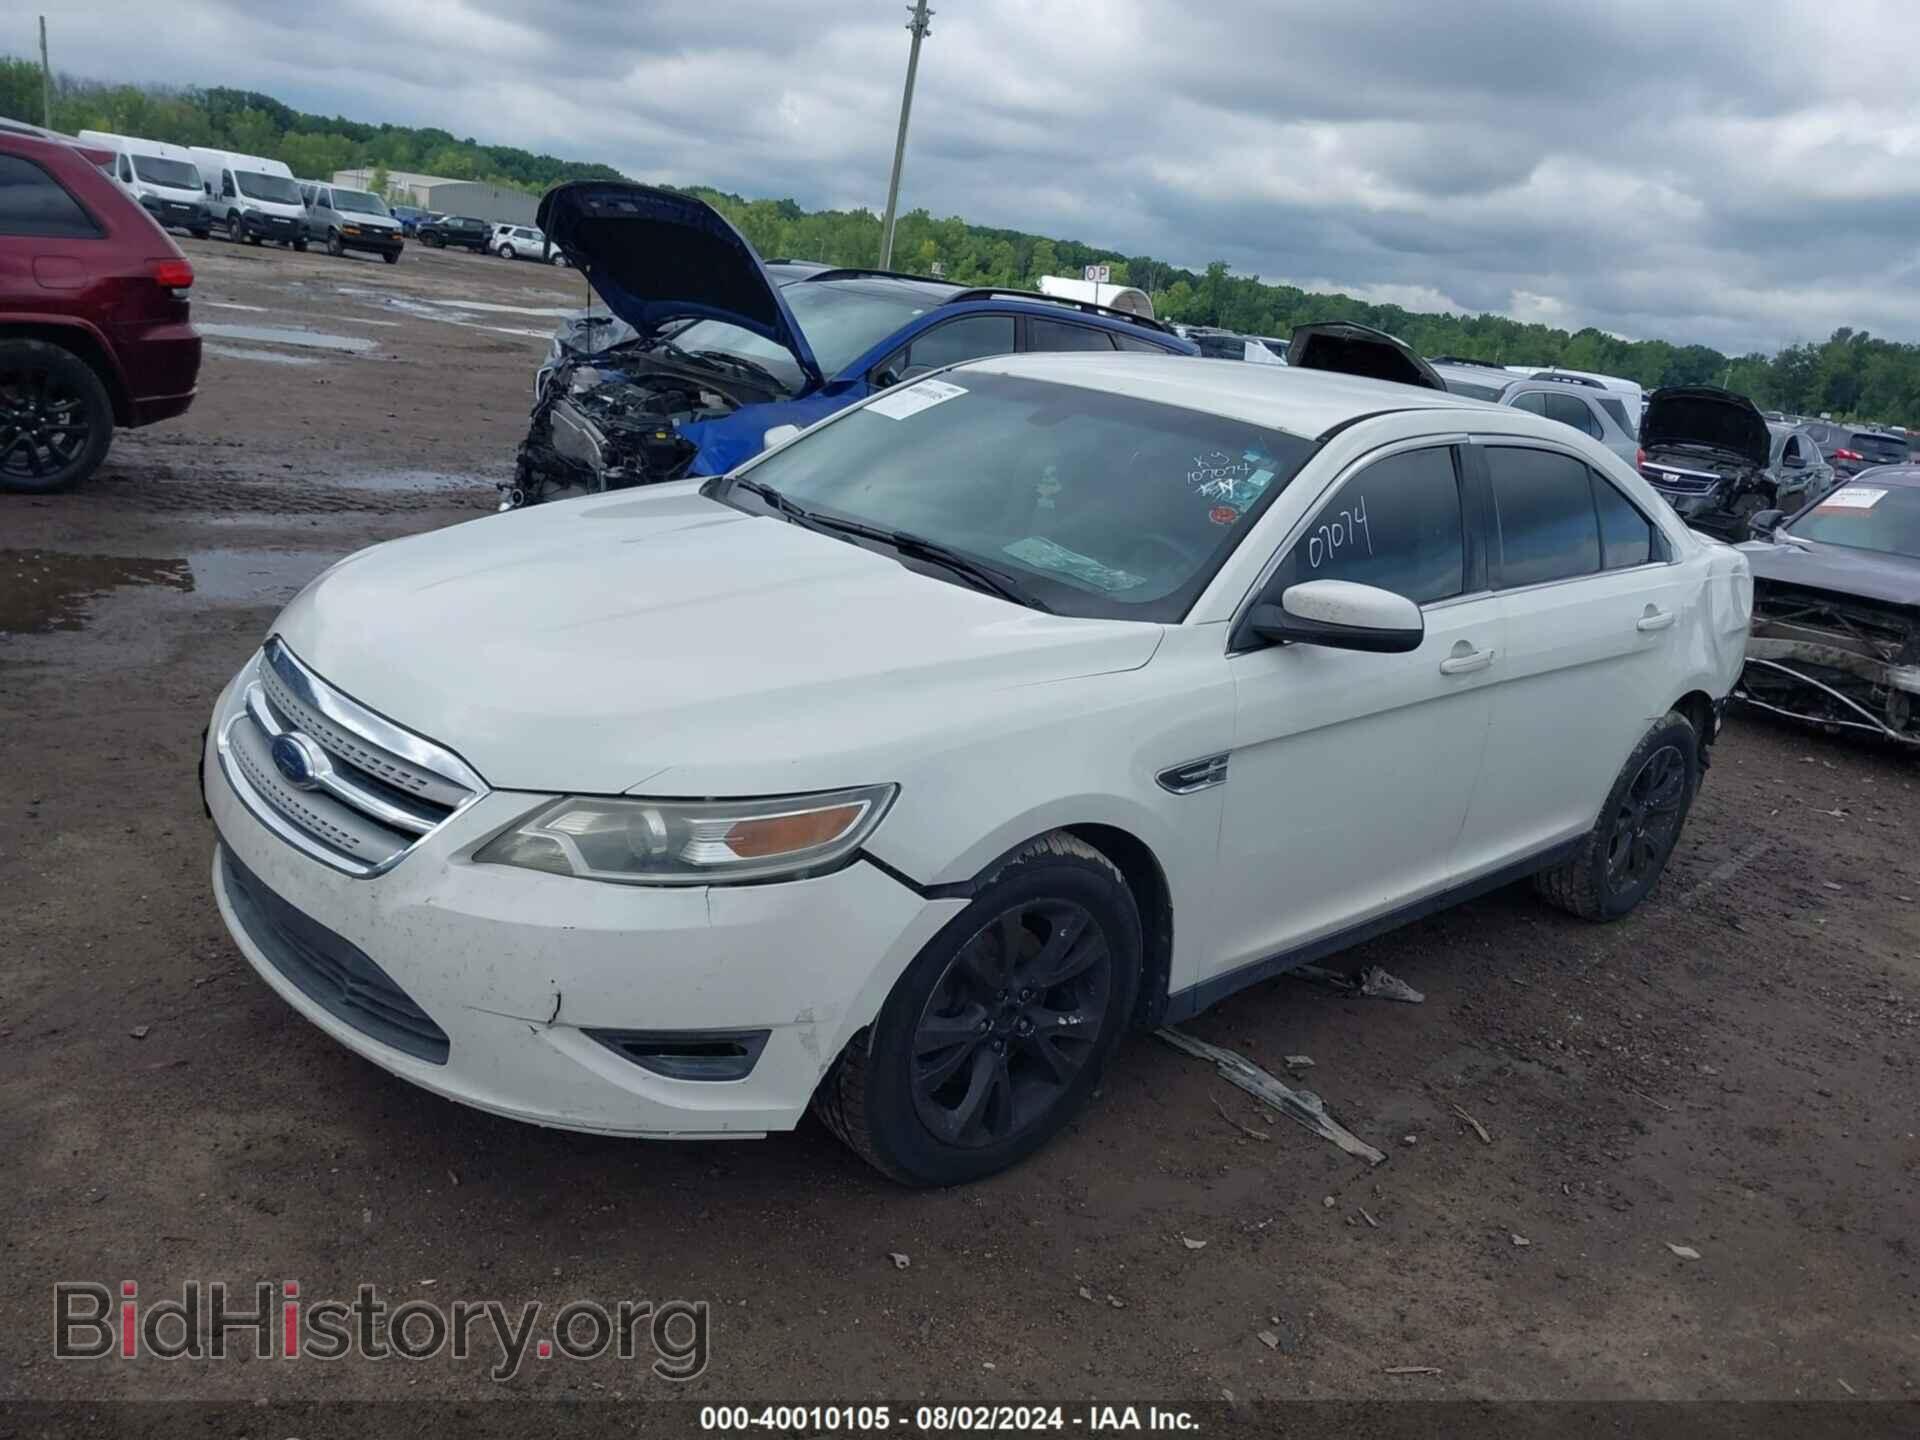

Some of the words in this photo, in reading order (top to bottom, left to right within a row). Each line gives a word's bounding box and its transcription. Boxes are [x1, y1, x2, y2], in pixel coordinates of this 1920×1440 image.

[1099, 266, 1107, 280] P
[1186, 463, 1251, 485] 107074
[1309, 495, 1373, 568] 07074
